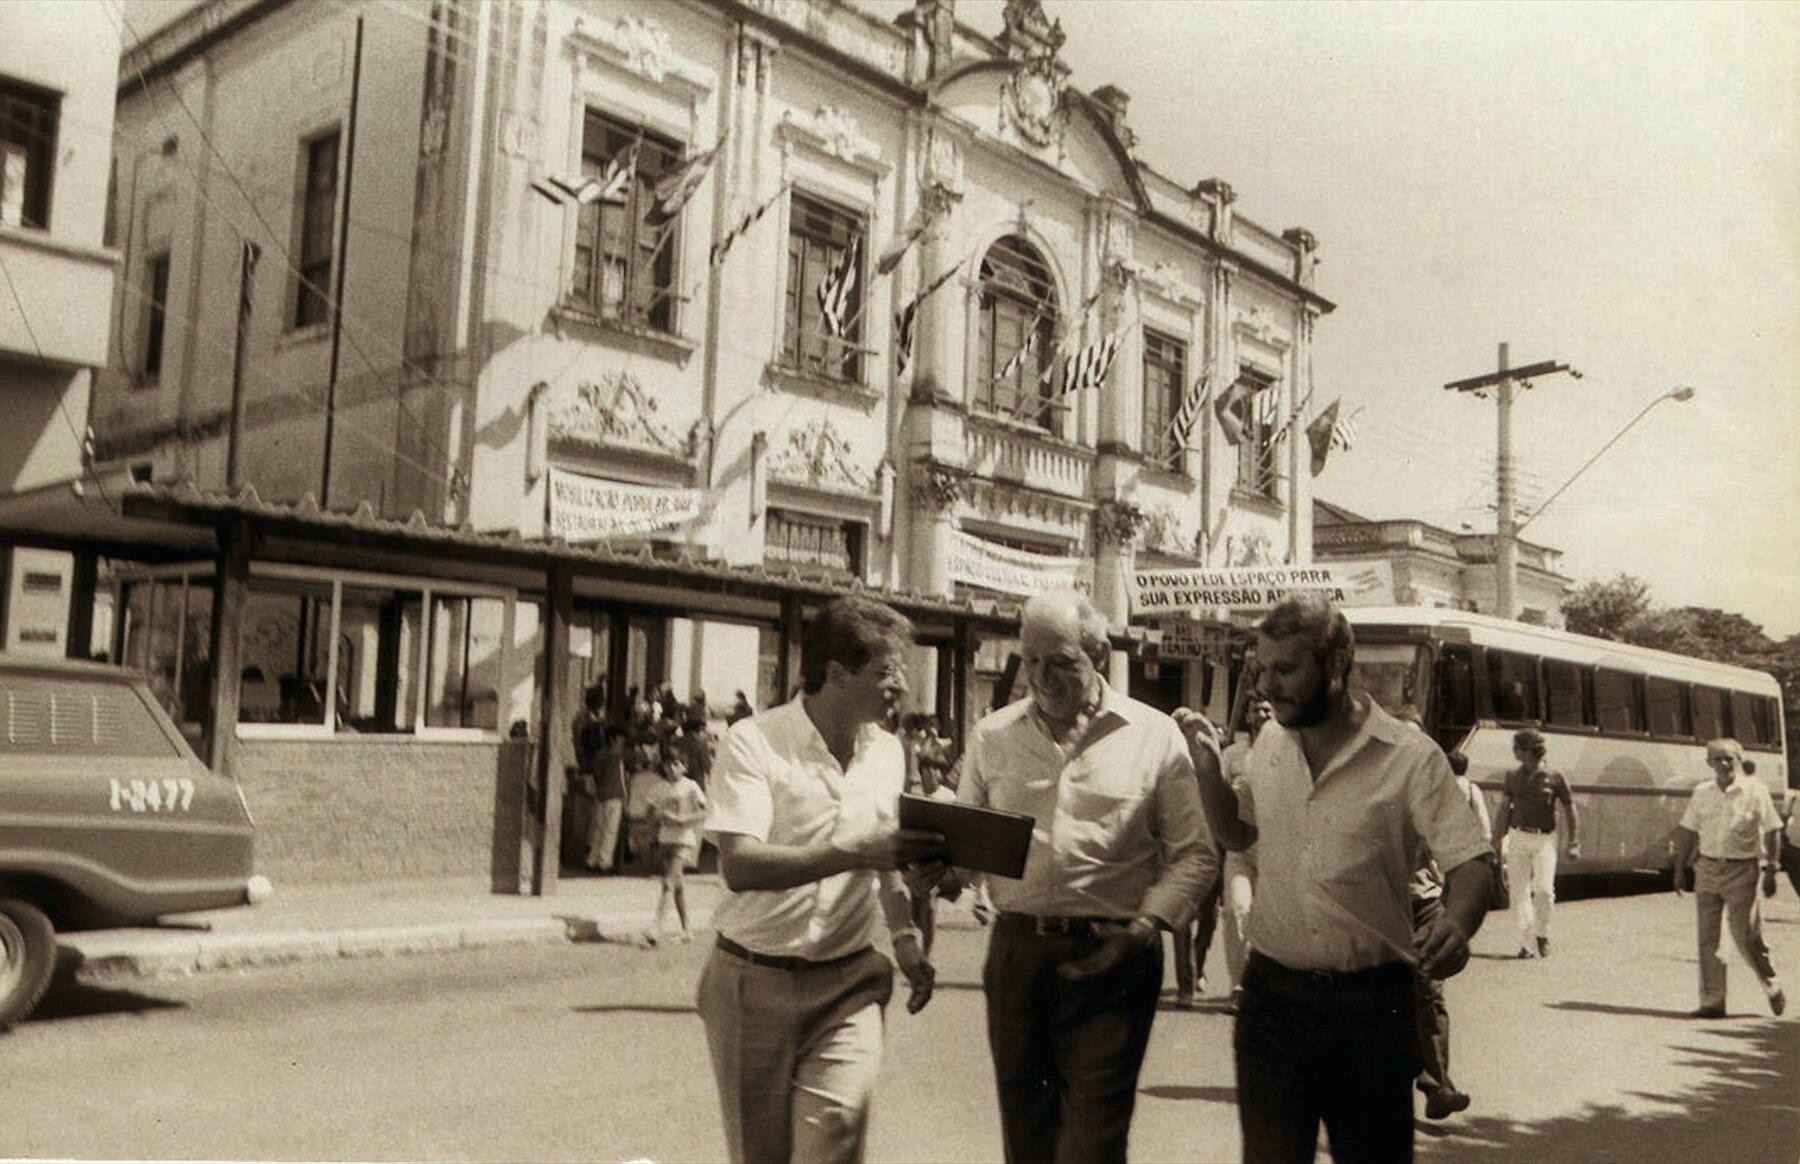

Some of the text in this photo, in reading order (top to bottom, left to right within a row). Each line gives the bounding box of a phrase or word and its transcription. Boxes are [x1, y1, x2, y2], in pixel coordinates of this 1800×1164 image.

[1136, 575, 1148, 588] O
[1150, 574, 1189, 587] POVO
[1290, 569, 1332, 584] PARA
[1140, 591, 1170, 607] SUA
[1174, 588, 1261, 605] EXPRESSÃO
